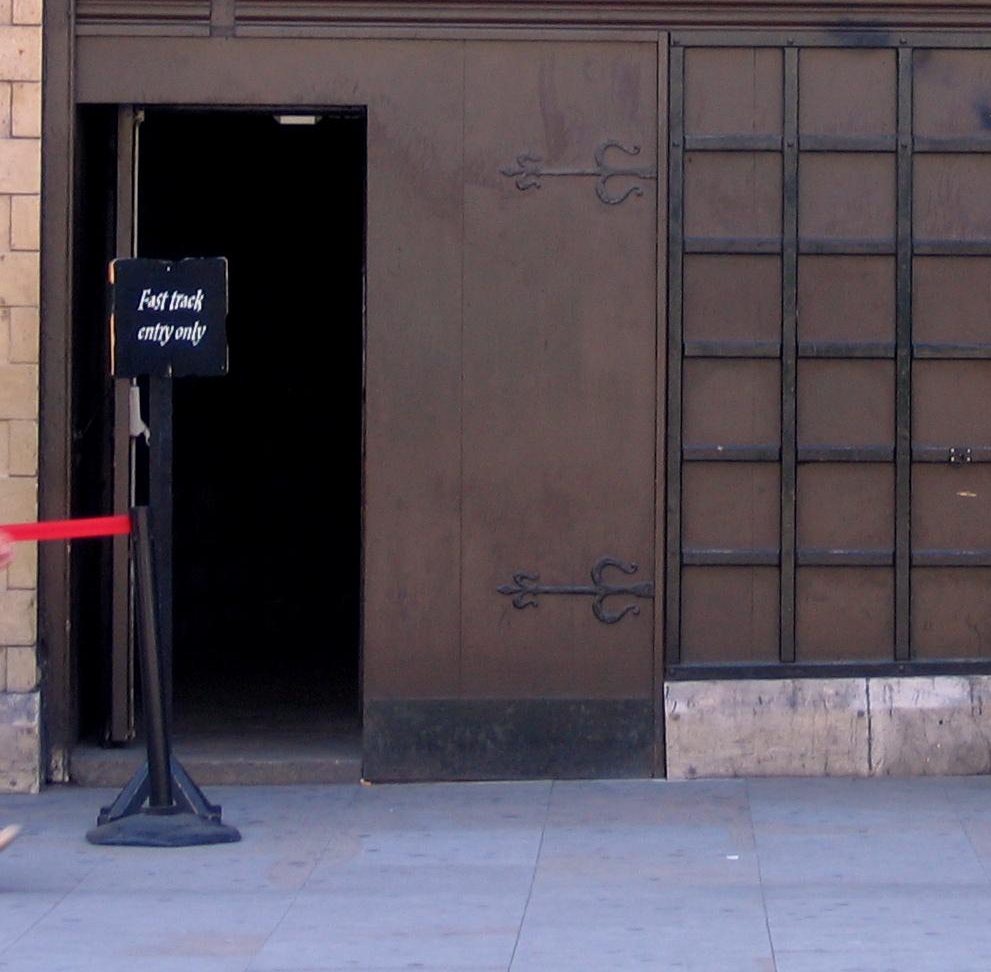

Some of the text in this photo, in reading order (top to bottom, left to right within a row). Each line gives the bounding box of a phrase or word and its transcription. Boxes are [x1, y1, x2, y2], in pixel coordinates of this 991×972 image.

[137, 288, 205, 312] Fast track
[137, 320, 207, 347] entry only
